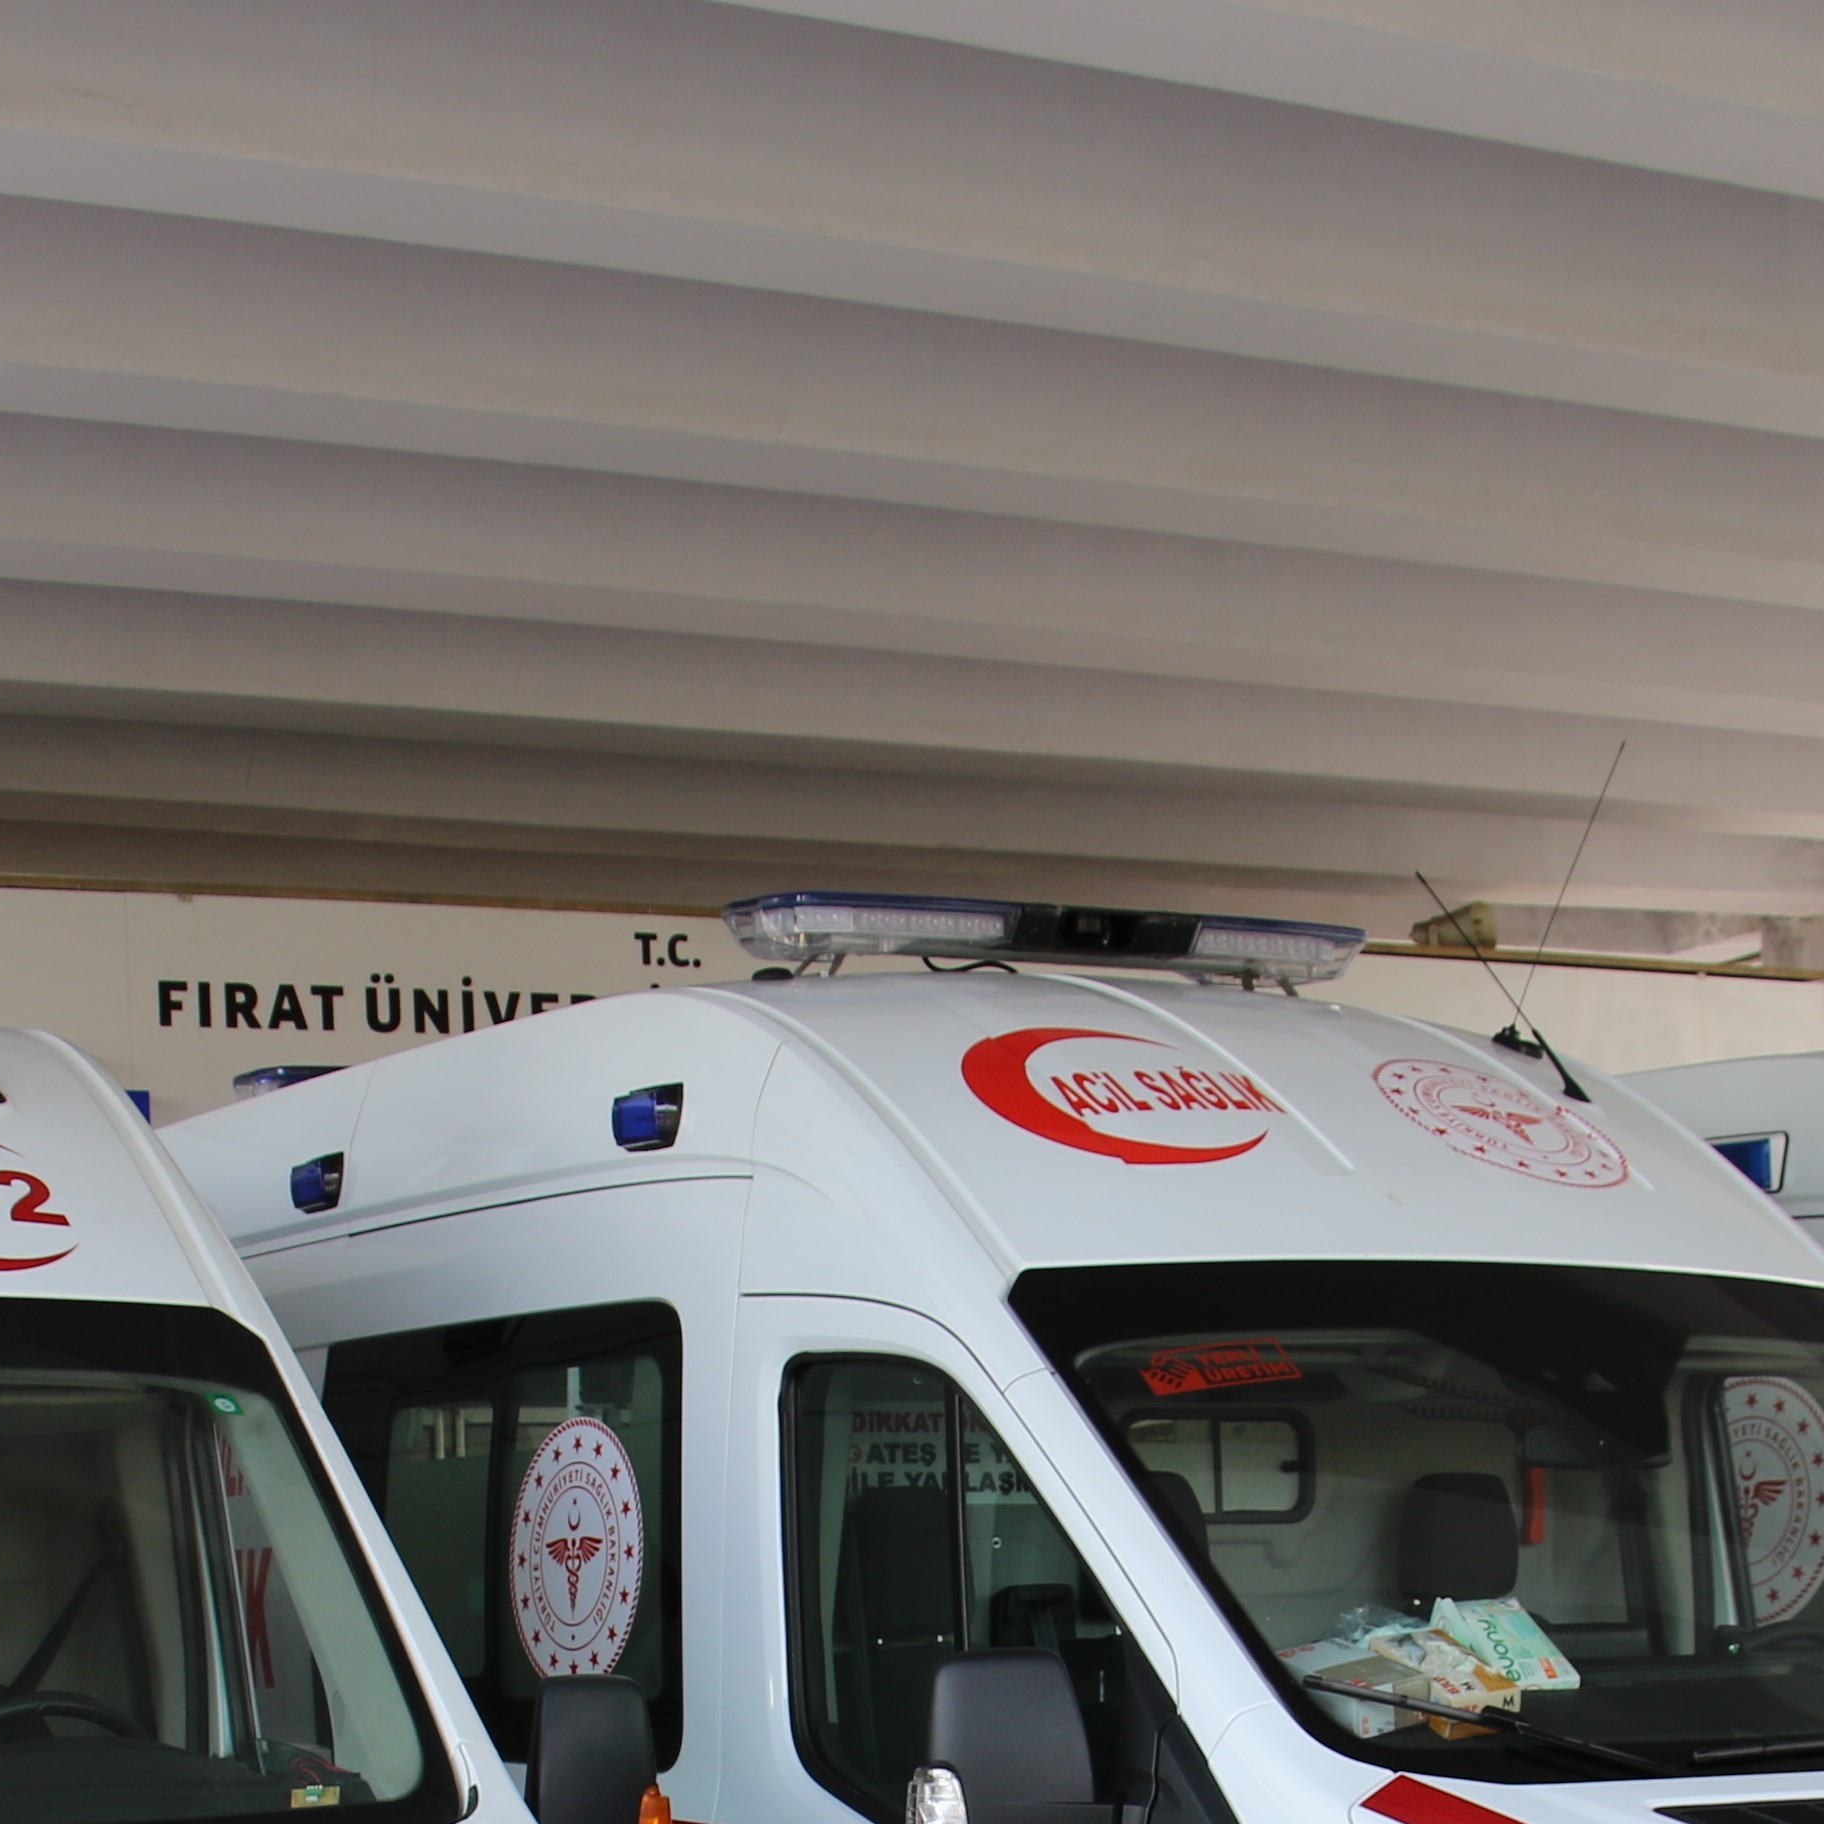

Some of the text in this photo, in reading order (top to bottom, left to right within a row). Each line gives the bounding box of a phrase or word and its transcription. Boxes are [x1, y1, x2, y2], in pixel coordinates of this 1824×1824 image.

[634, 931, 702, 968] T.C.
[157, 973, 596, 1034] FIRAT ÜNİV
[1133, 1064, 1286, 1114] SAĞLIK
[852, 1410, 944, 1434] DİKKAT
[865, 1442, 937, 1467] ATEŞ
[533, 1466, 584, 1555] CUMHURİYETİ
[585, 1472, 613, 1519] SAĞLIK
[592, 1525, 617, 1627] BAKANLIĞI
